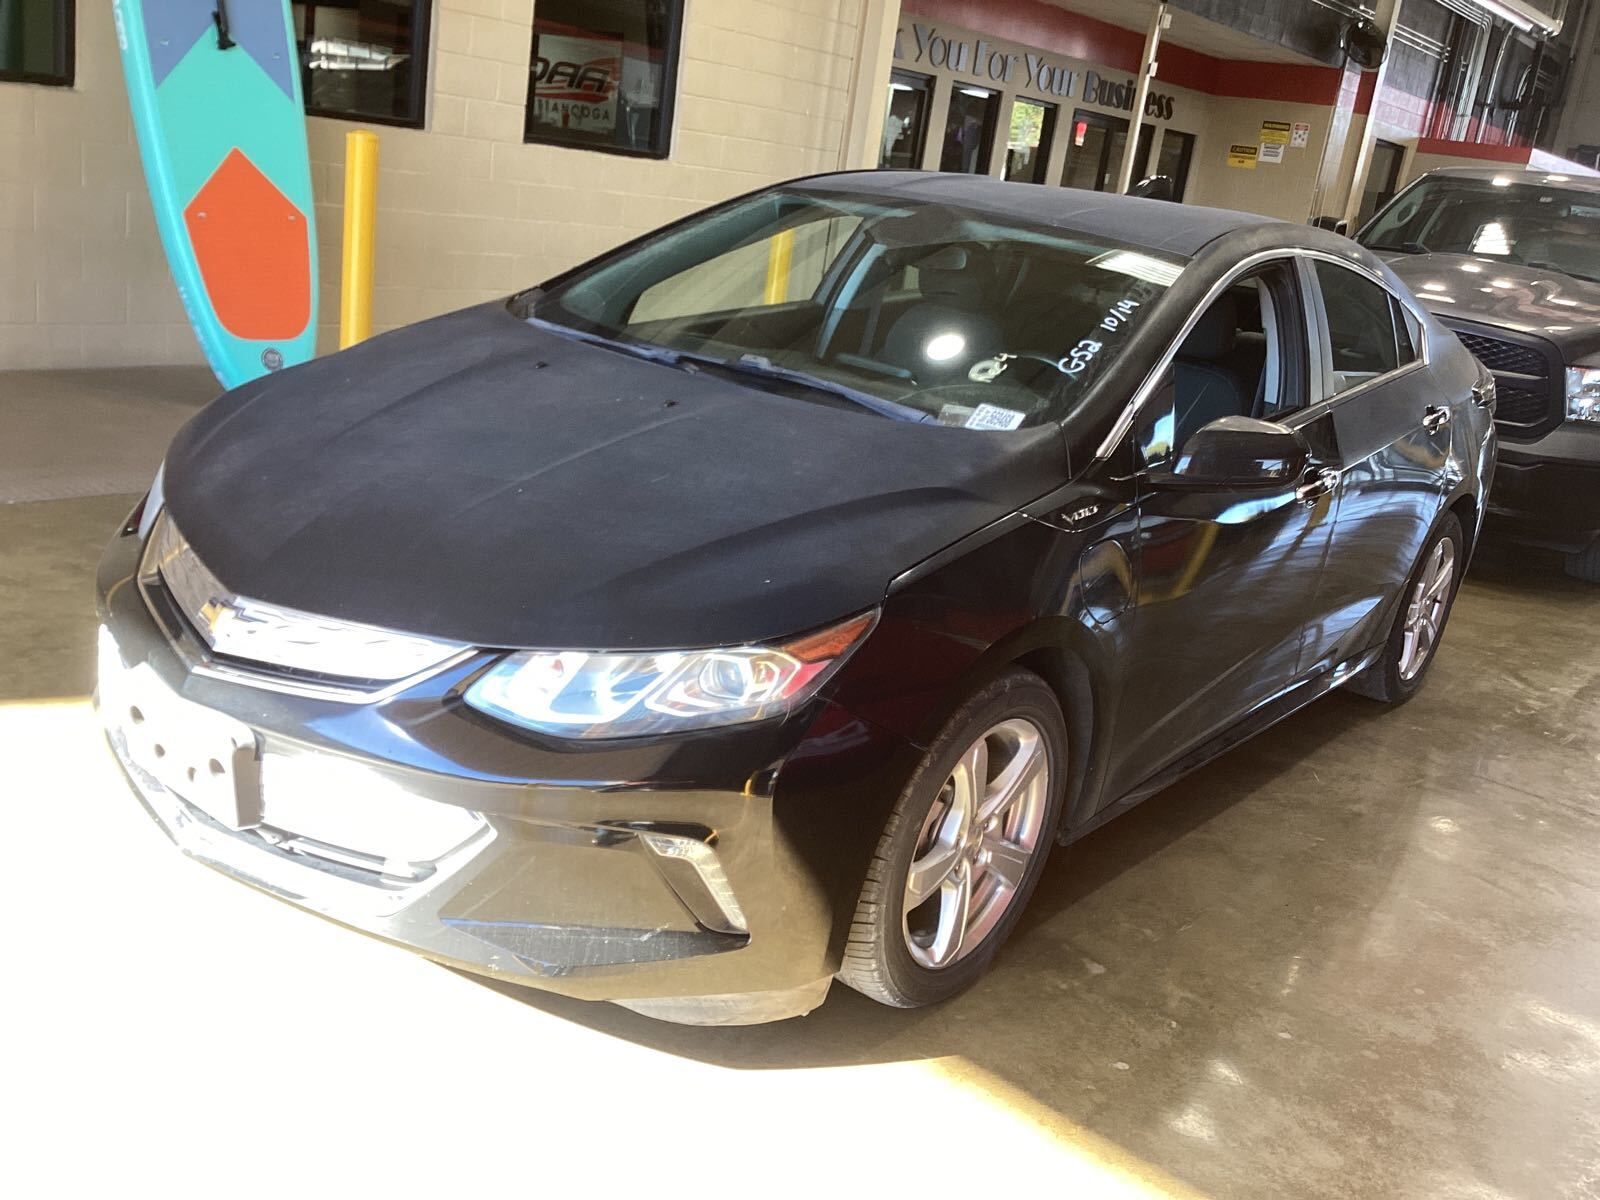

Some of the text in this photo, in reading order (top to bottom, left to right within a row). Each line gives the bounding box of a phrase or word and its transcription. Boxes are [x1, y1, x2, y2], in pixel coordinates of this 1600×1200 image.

[912, 23, 969, 72] You
[972, 39, 1019, 83] For
[1024, 53, 1080, 97] Your
[1082, 69, 1175, 120] Busiess
[1100, 299, 1141, 332] 10/14
